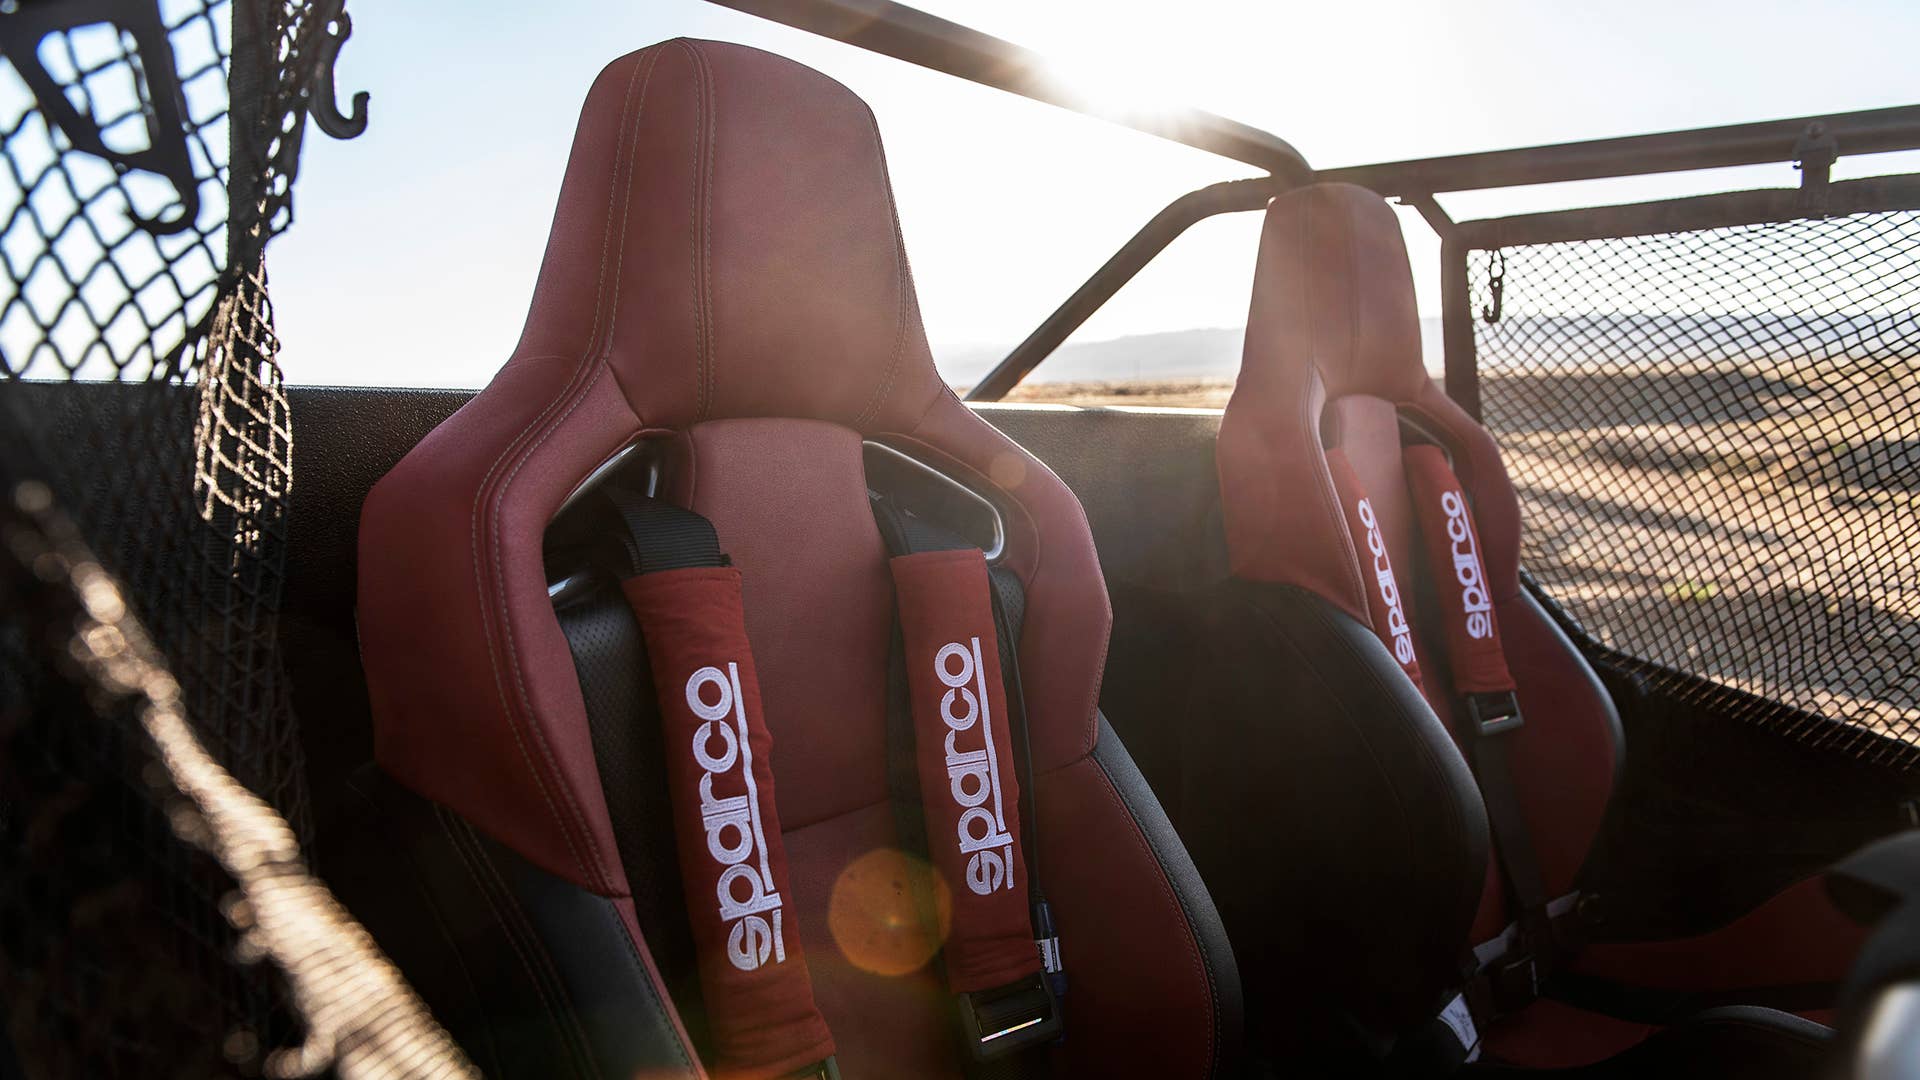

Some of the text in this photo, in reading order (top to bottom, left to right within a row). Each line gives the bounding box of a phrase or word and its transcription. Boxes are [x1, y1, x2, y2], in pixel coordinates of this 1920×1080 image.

[1358, 498, 1416, 664] sparco
[1441, 491, 1493, 639] sparco
[686, 662, 785, 971] sparco
[935, 637, 1014, 895] sparco
